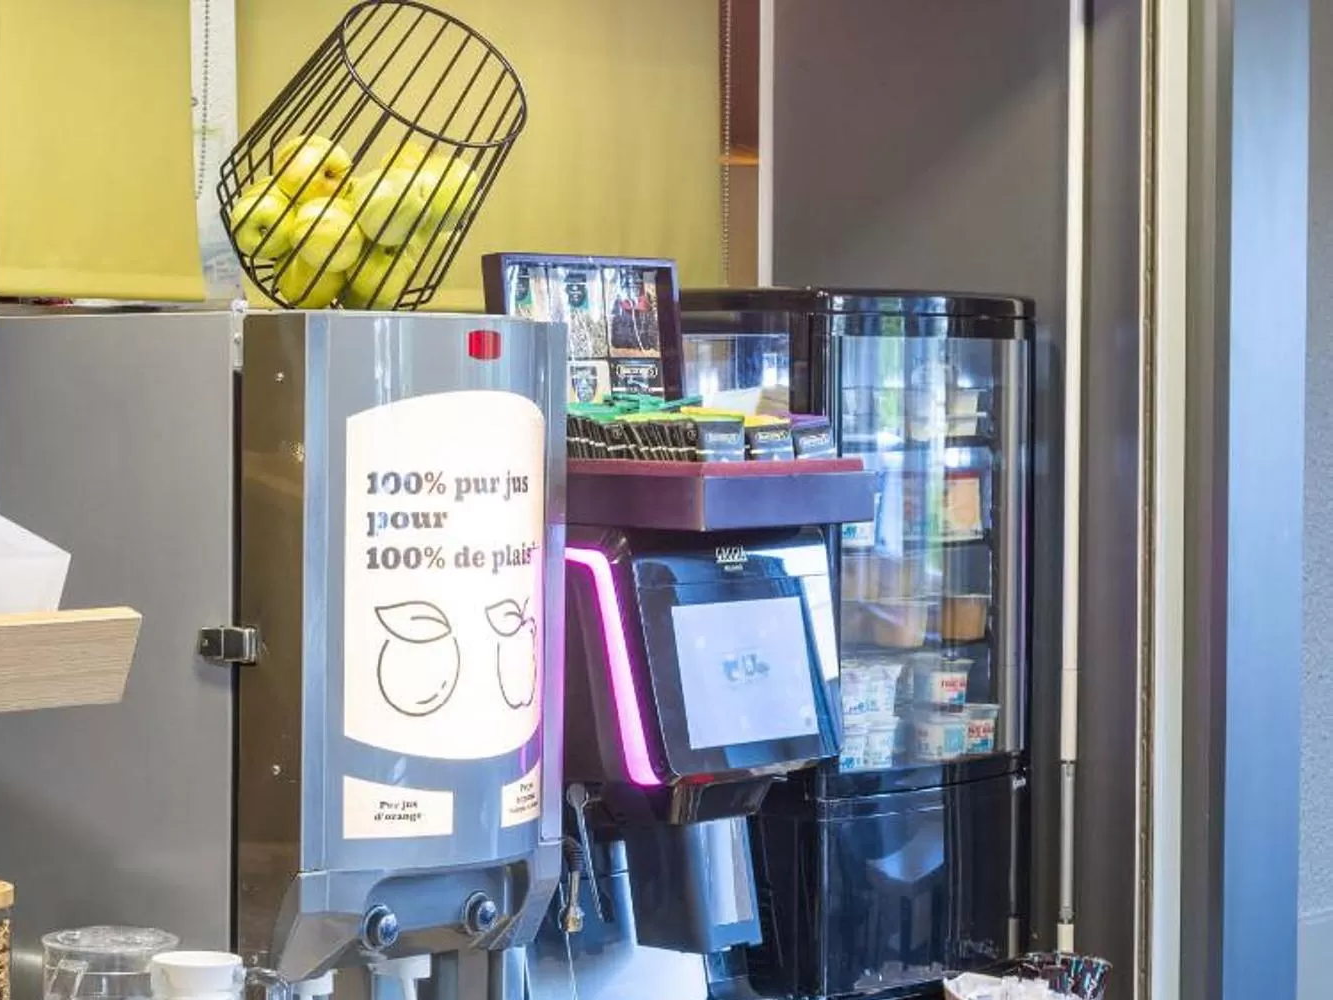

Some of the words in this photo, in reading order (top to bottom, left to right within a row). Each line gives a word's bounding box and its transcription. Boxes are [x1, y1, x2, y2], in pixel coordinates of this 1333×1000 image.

[366, 470, 447, 495] 100%
[454, 474, 500, 502] pur
[503, 469, 529, 501] jus
[366, 511, 448, 538] pour
[366, 546, 446, 570] 100%
[454, 545, 486, 568] de
